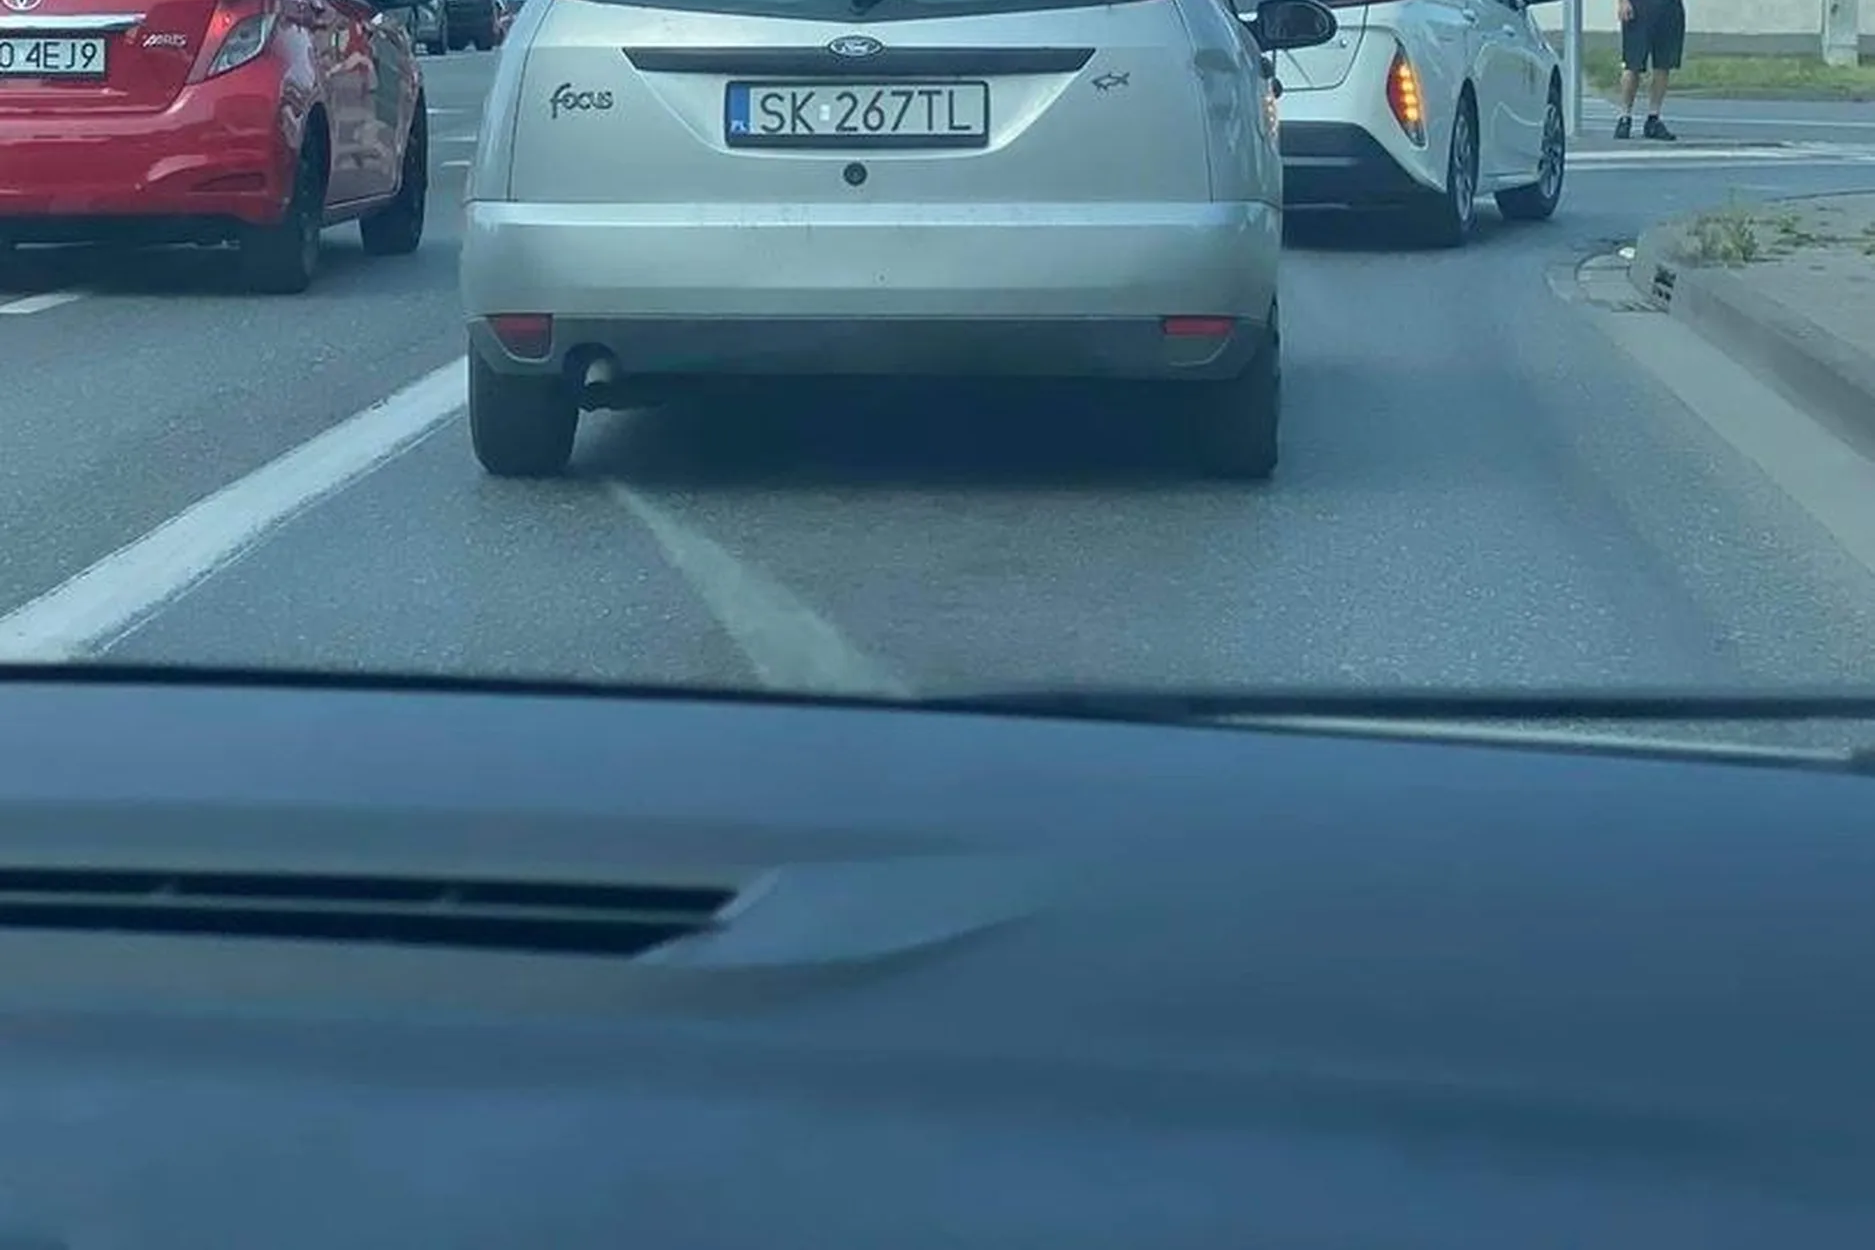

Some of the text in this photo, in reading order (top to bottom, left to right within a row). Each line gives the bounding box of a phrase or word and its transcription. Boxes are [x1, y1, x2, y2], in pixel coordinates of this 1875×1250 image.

[25, 41, 97, 68] 4EJ9
[549, 82, 614, 119] focus
[760, 90, 971, 133] SK 267TL
